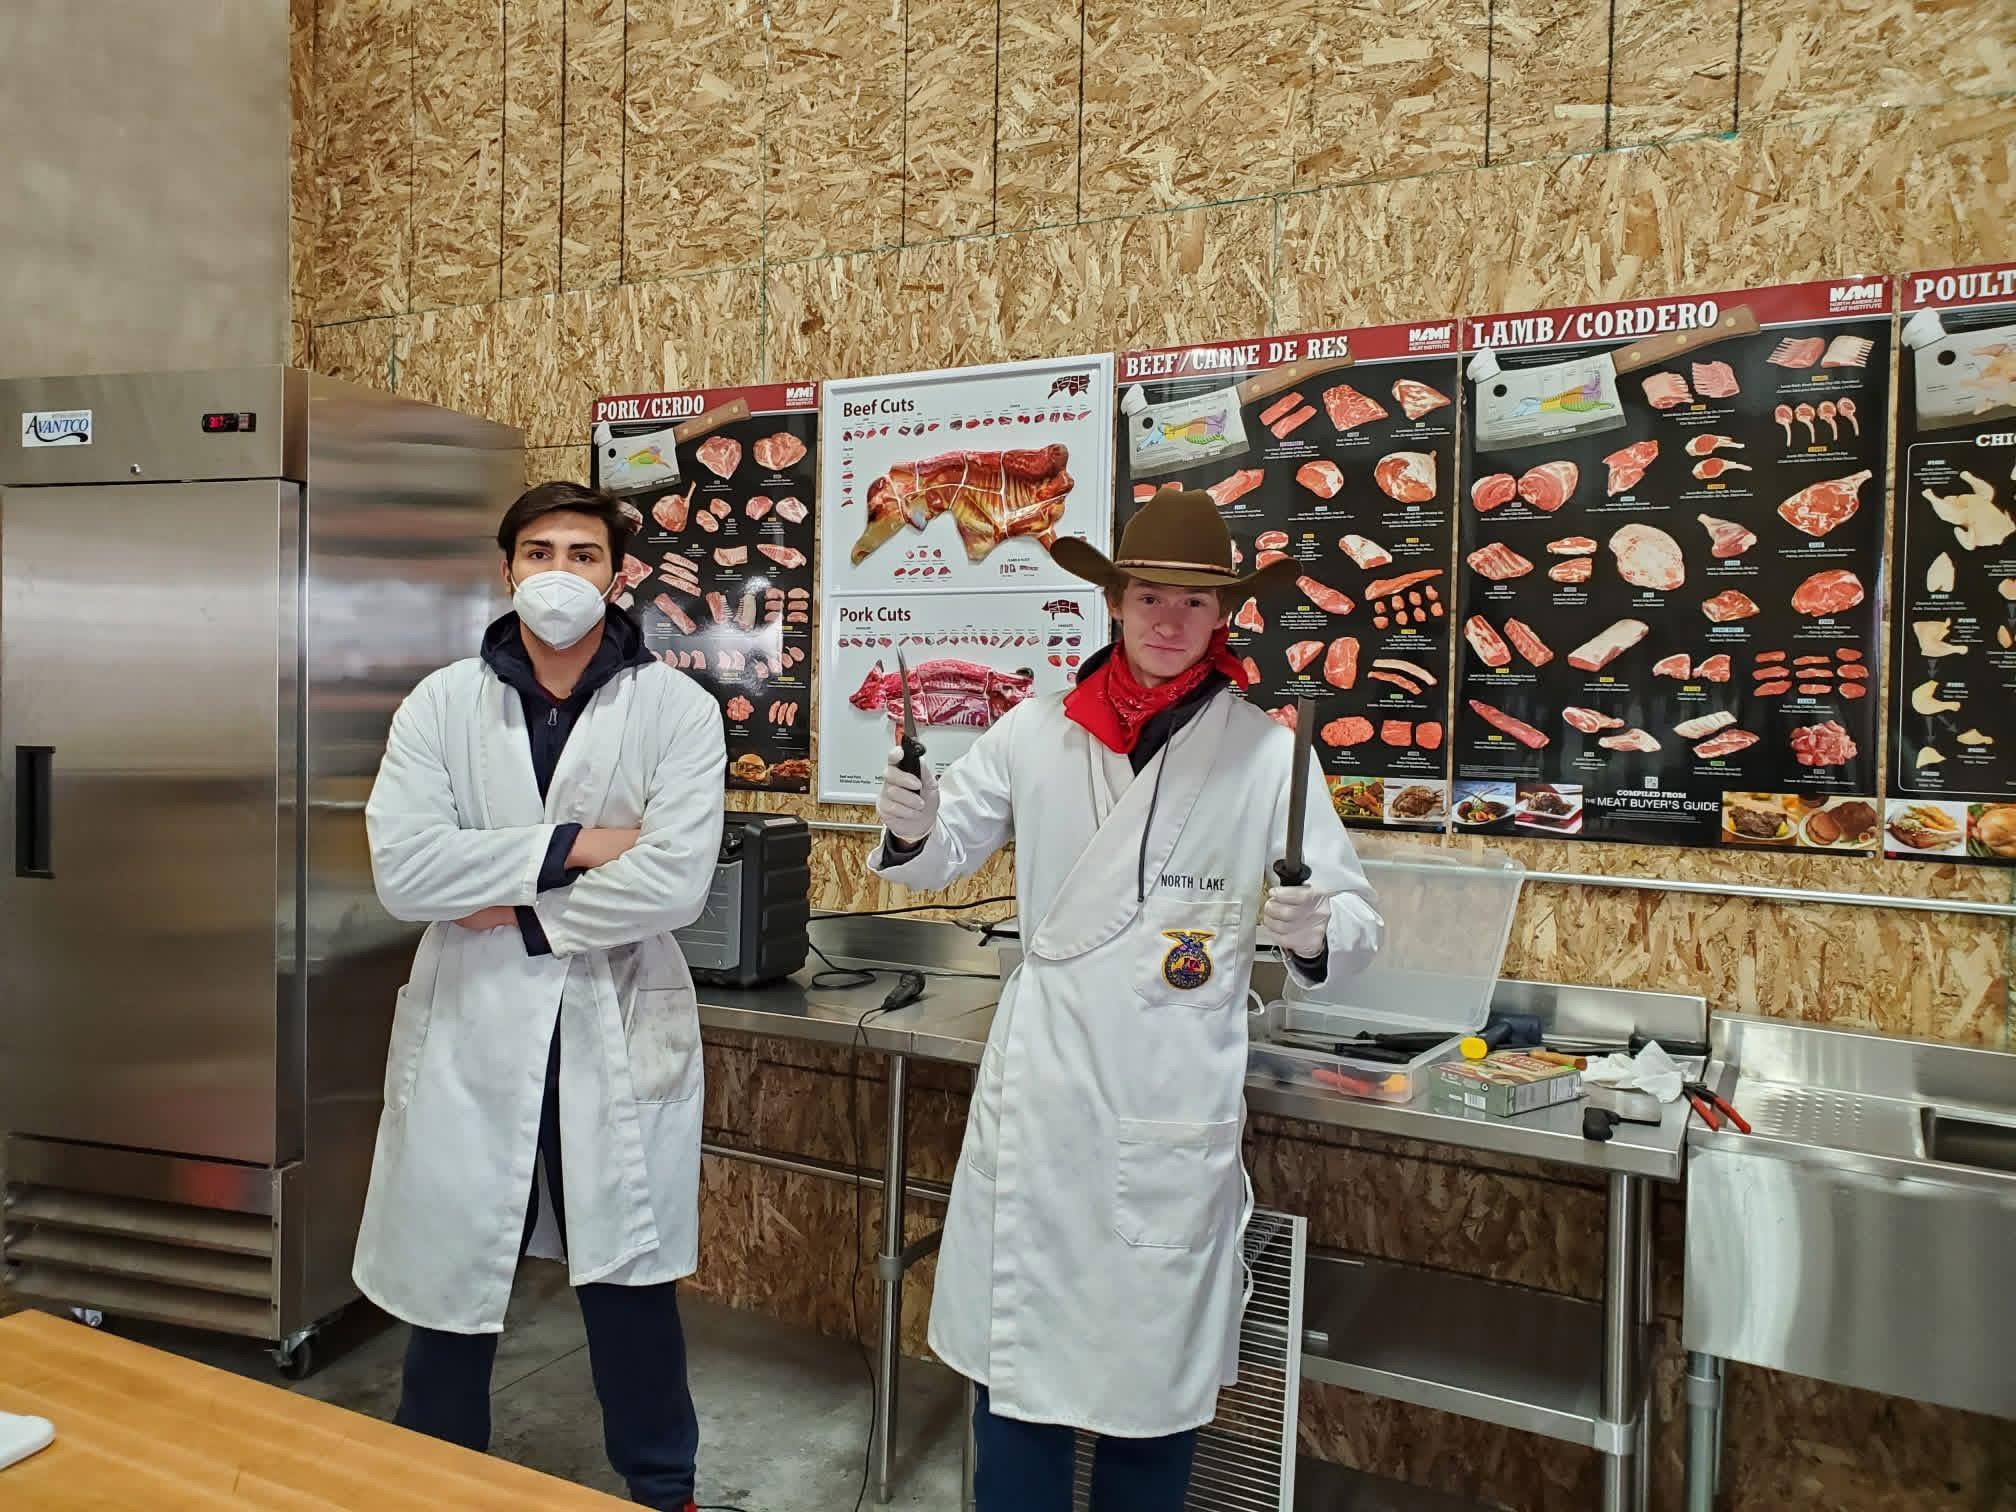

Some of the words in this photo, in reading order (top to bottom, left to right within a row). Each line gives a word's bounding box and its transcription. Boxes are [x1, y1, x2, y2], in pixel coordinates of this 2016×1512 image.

[1829, 283, 1883, 302] NAMI
[1409, 326, 1451, 342] NAMI
[1268, 341, 1298, 363] DE
[1307, 335, 1349, 360] RES
[843, 399, 878, 417] Beef
[880, 398, 915, 414] Cuts
[25, 415, 89, 441] AVANTCO
[840, 606, 874, 622] Pork
[877, 606, 911, 622] Cuts
[1616, 789, 1661, 798] COMPILED
[1661, 791, 1687, 799] FROM
[1597, 796, 1627, 807] MEAT
[1630, 798, 1680, 809] BUYER'S
[1683, 801, 1720, 812] GUIDE
[1161, 874, 1194, 889] NORTH
[1199, 876, 1225, 891] LAKE
